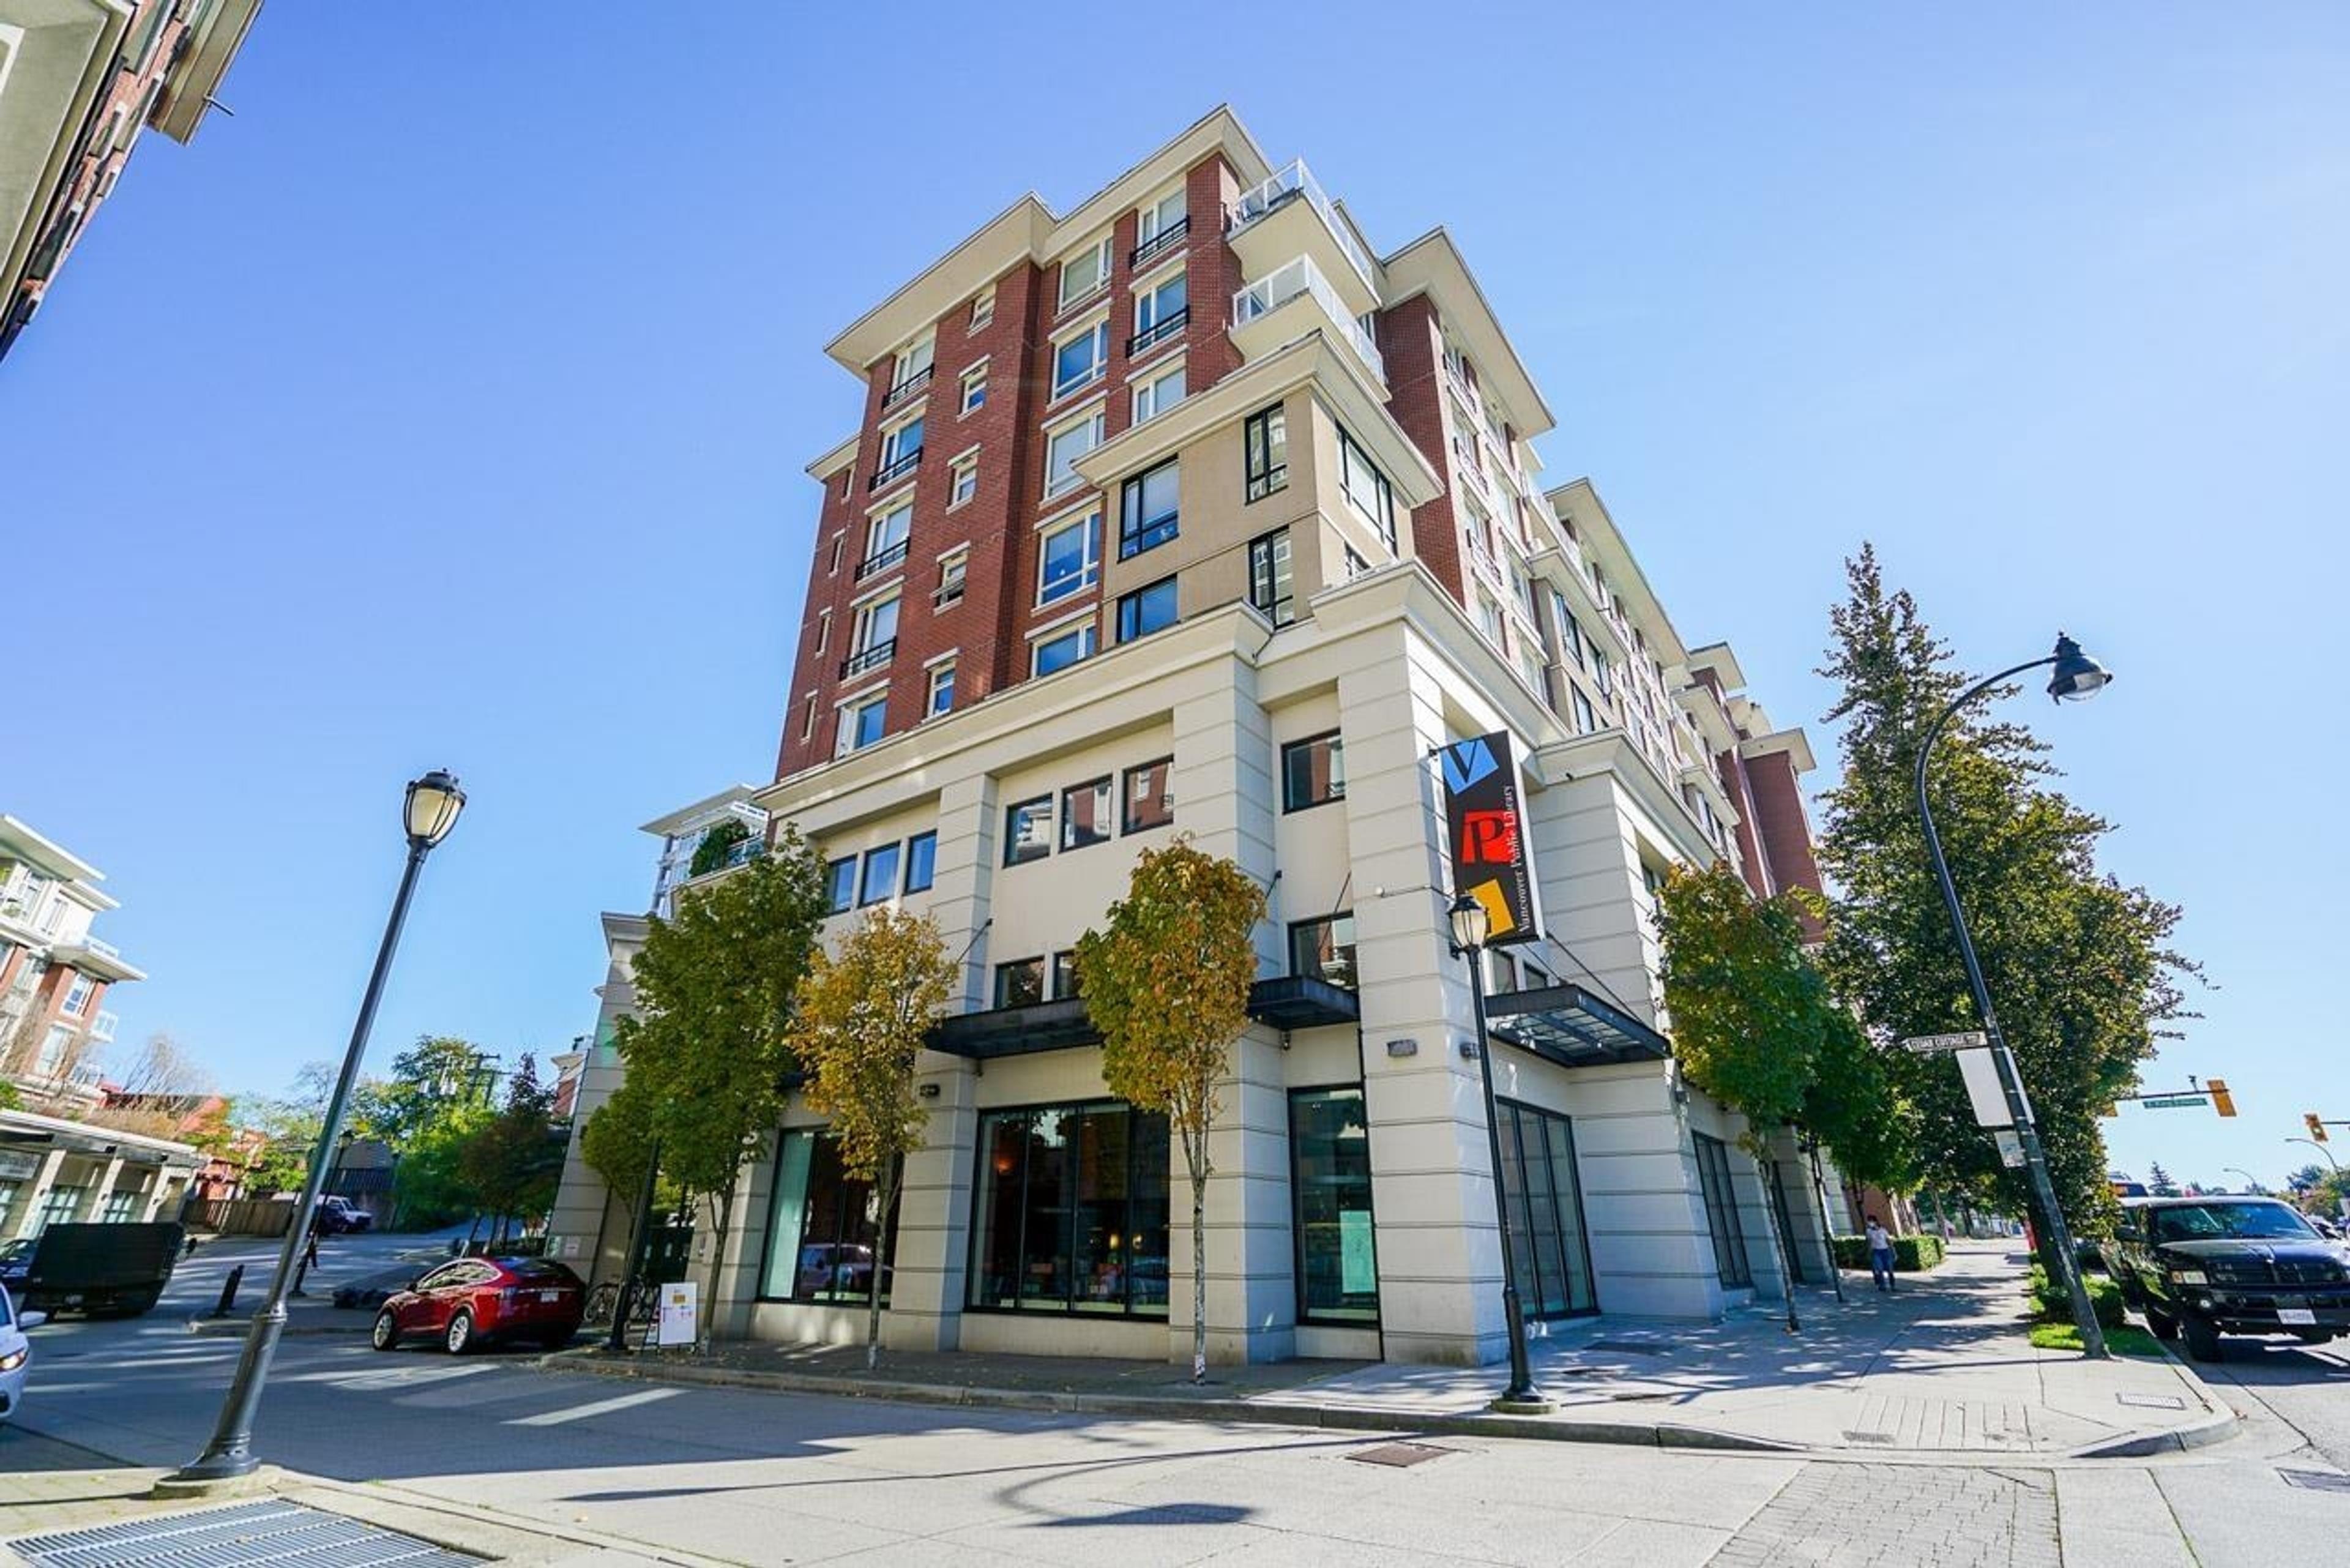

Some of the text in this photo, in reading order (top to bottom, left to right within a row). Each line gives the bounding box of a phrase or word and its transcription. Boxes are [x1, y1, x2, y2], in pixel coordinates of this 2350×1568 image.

[1503, 785, 1531, 932] Vancouver Public Library
